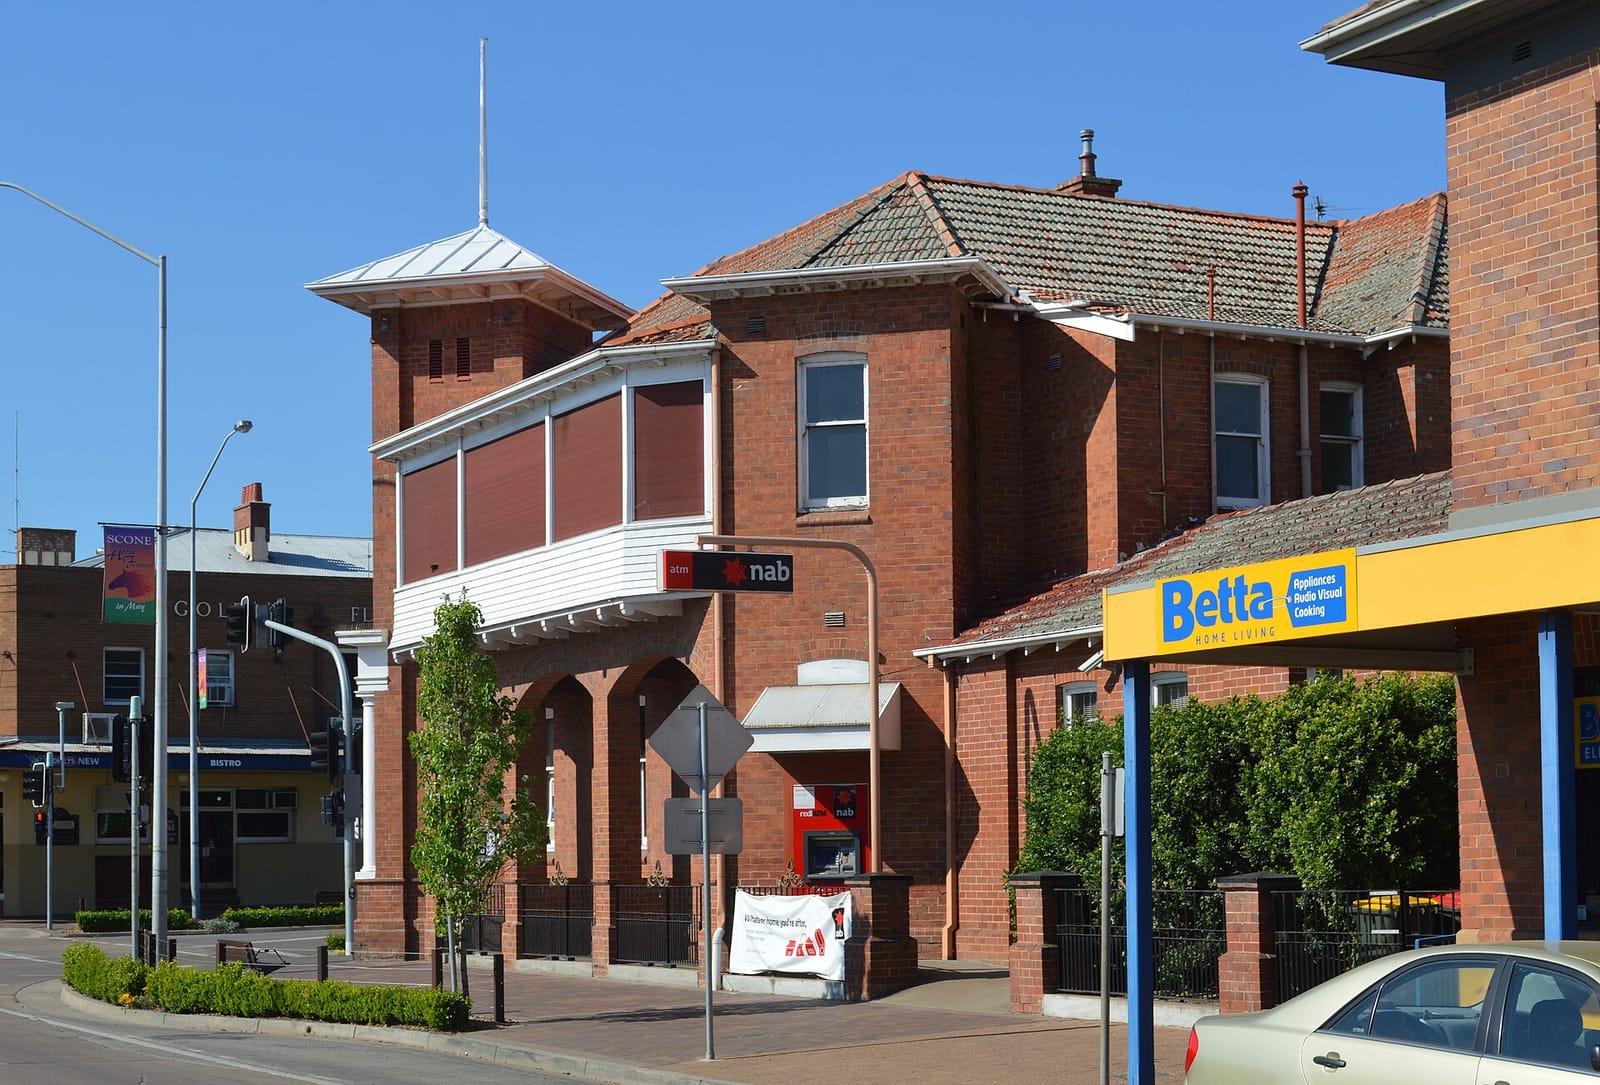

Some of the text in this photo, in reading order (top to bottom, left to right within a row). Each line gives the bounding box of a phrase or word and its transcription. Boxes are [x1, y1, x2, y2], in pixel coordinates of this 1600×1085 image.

[107, 534, 152, 545] SCONE
[669, 565, 689, 574] atm
[749, 560, 790, 582] nab
[1293, 574, 1336, 591] Appliances
[1294, 585, 1343, 604] Audio Visual
[116, 601, 145, 613] in May
[1162, 574, 1274, 643] Betta
[1294, 604, 1326, 619] Cooking
[1195, 626, 1276, 646] HOME LIVING
[77, 757, 100, 766] NEW
[210, 759, 242, 767] BISTRO
[836, 807, 854, 817] nab
[766, 917, 780, 927] home
